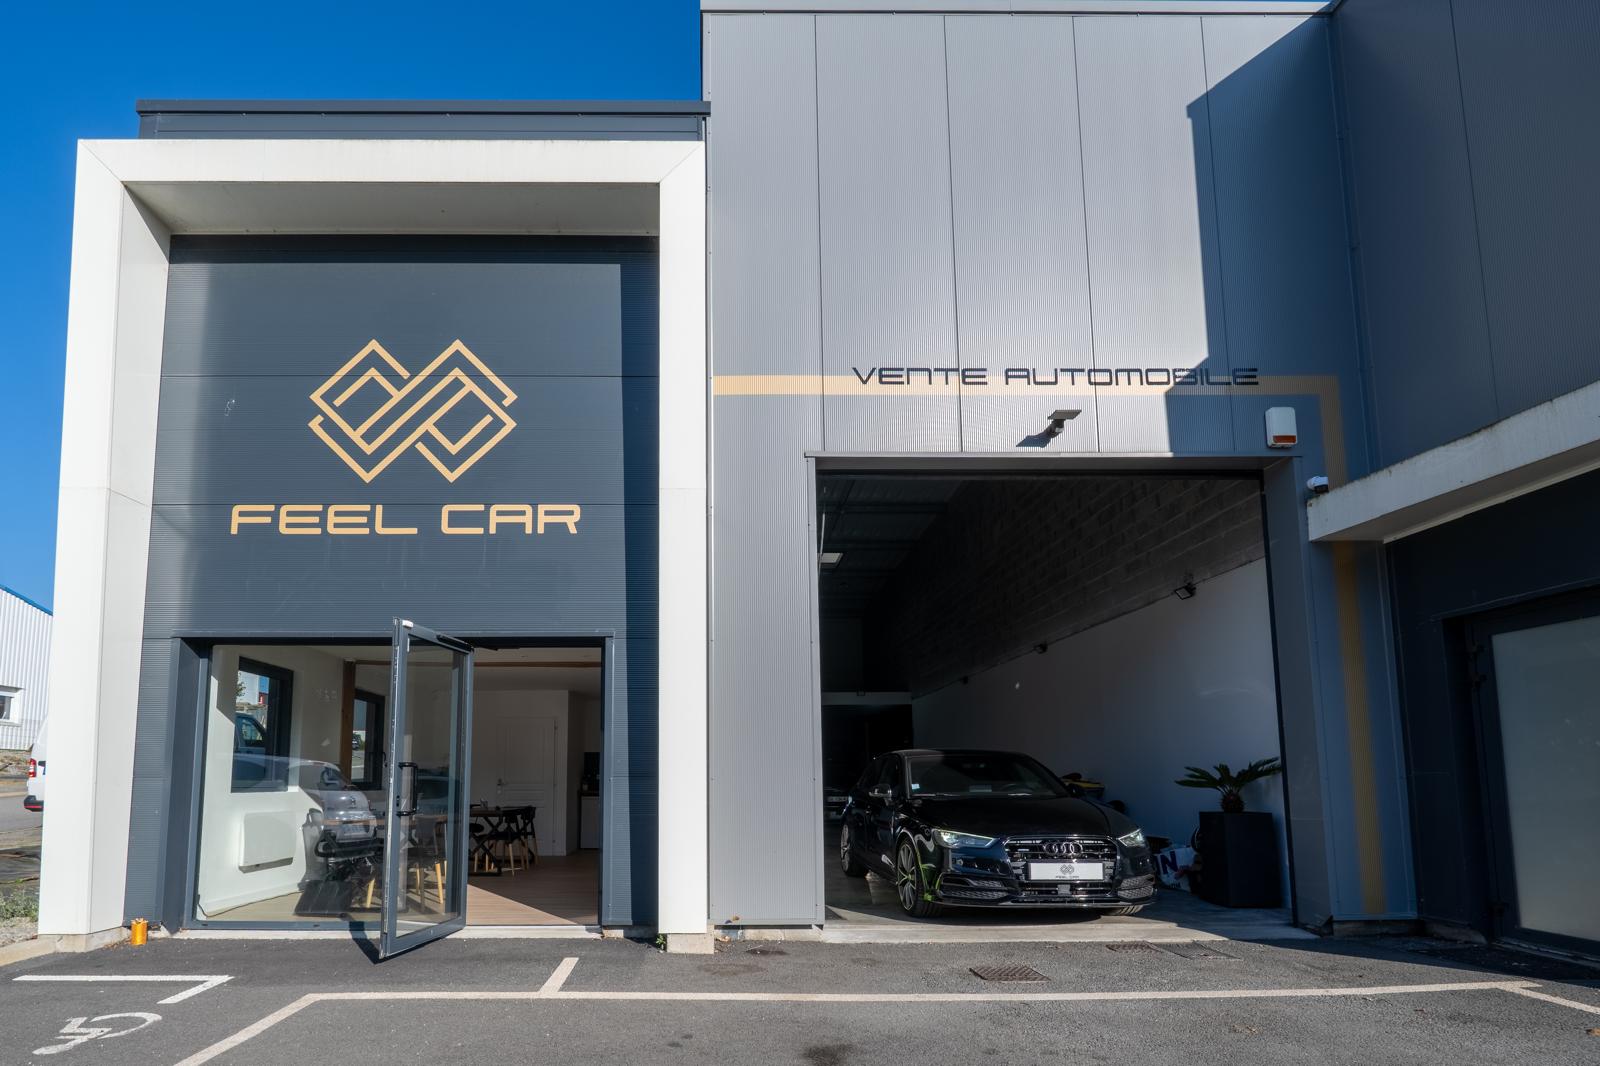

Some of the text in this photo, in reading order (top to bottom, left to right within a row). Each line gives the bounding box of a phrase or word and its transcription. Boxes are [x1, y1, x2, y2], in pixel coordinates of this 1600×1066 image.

[852, 367, 1259, 386] VENTE AUTOMOBILE
[230, 504, 581, 535] FEEL CAR
